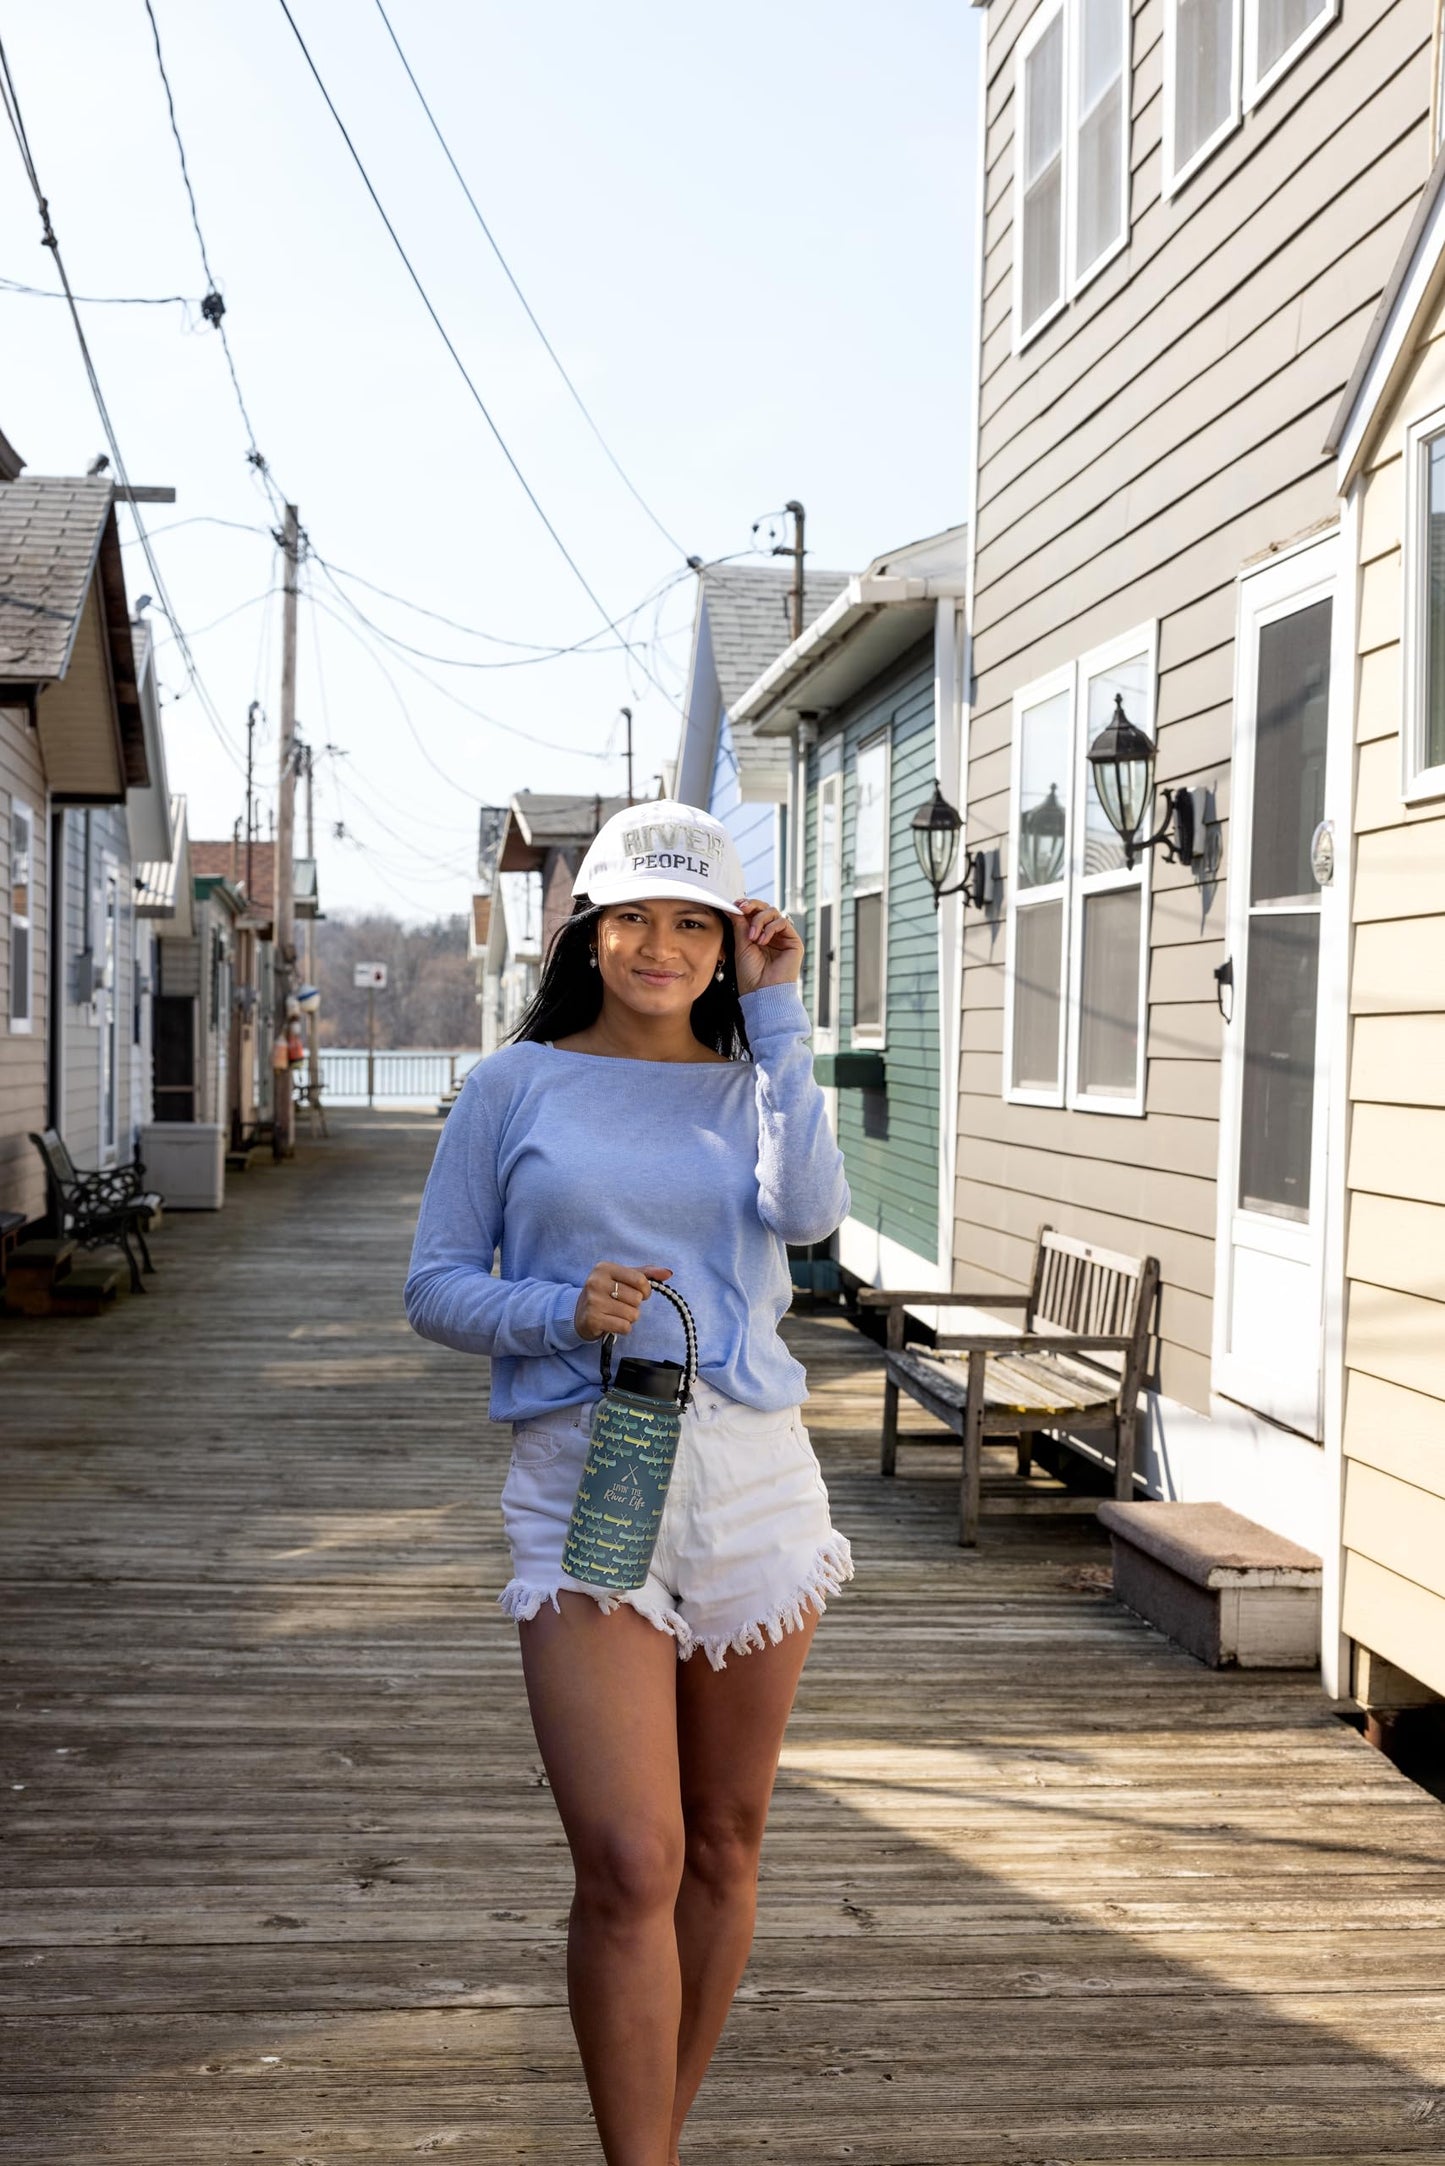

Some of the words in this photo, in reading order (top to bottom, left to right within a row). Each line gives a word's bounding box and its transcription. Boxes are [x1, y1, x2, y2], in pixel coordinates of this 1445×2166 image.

[622, 823, 725, 861] RIVER
[632, 853, 710, 877] PEOPLE
[603, 1488, 628, 1503] River
[628, 1495, 646, 1511] Life
